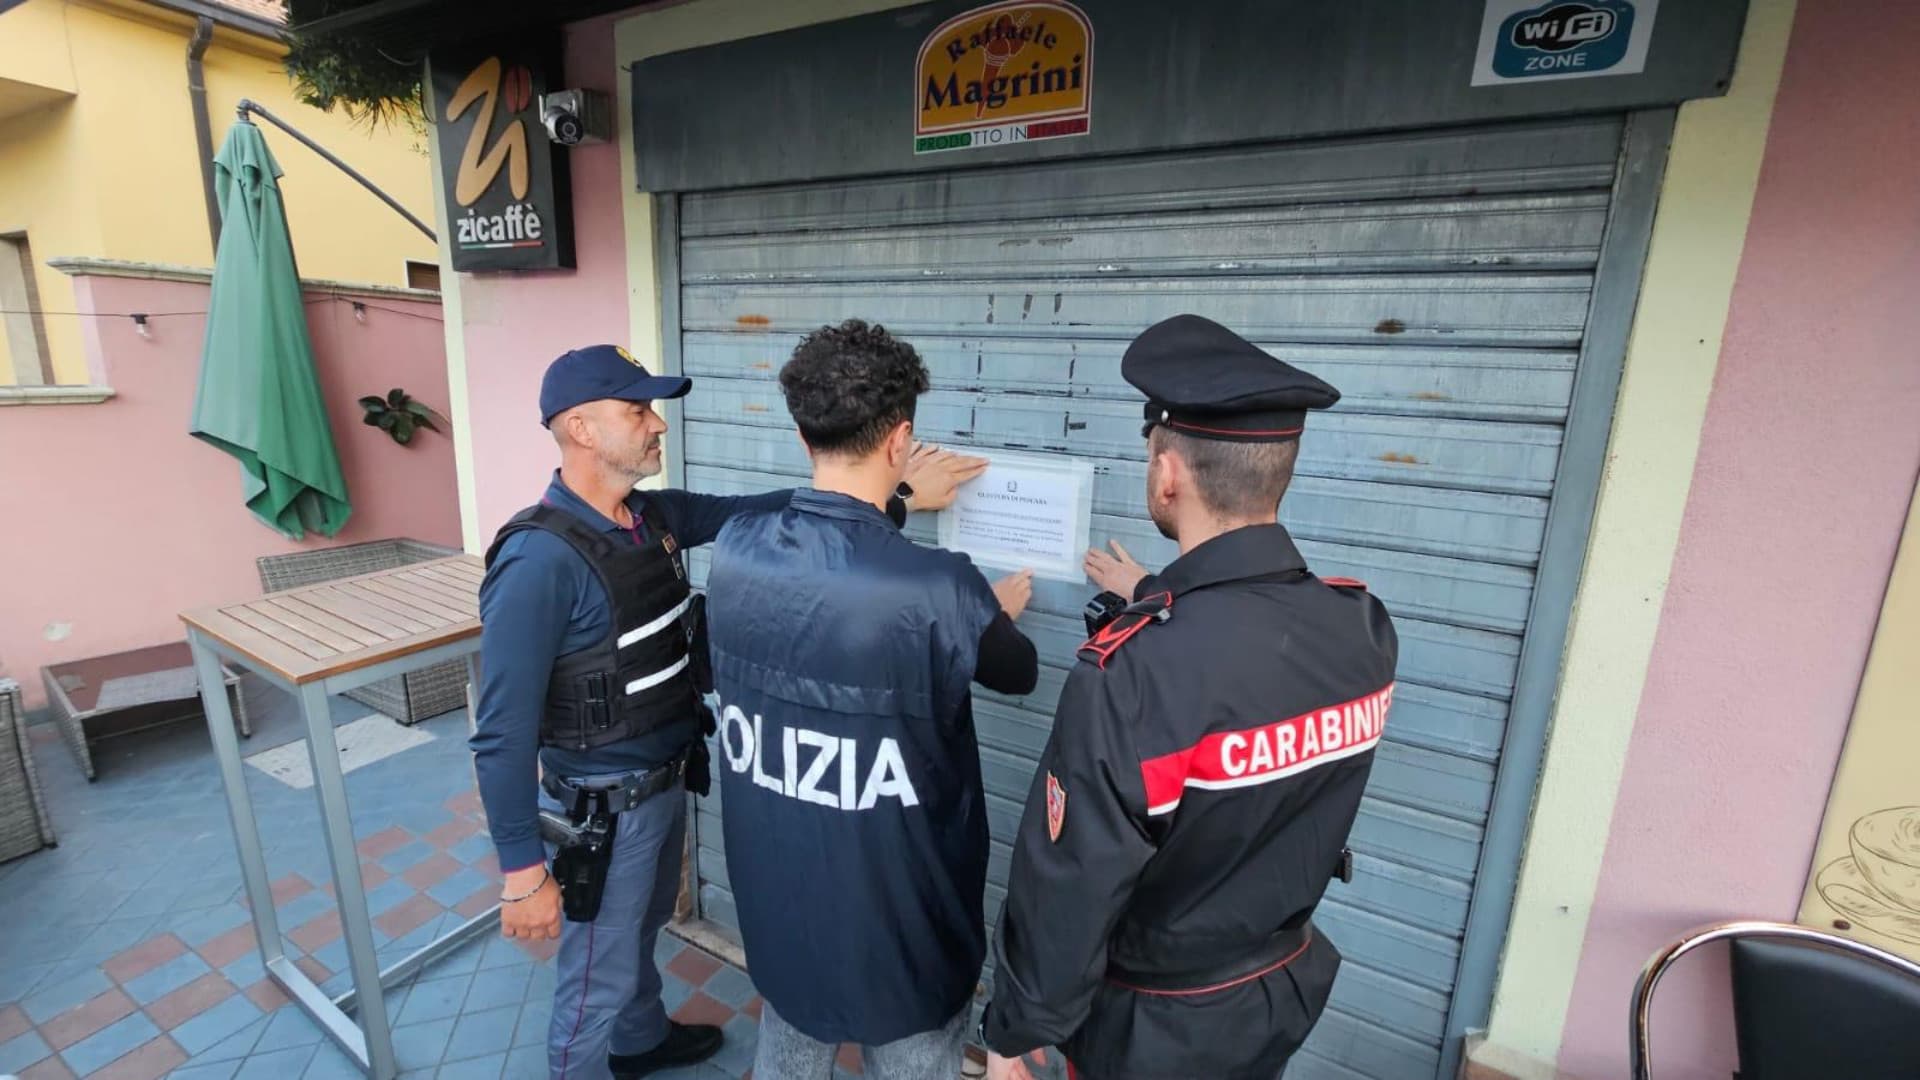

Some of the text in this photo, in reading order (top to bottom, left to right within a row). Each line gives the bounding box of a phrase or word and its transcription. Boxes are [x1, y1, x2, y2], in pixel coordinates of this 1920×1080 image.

[946, 20, 1058, 63] Raffaele
[1523, 52, 1587, 71] ZONE
[923, 53, 1083, 110] Magrini
[918, 128, 1003, 150] PRODOTTO
[1009, 126, 1027, 141] IN
[457, 203, 542, 243] zicaffè
[714, 690, 920, 811] OLIZIA
[1220, 683, 1393, 777] CARABINIE
